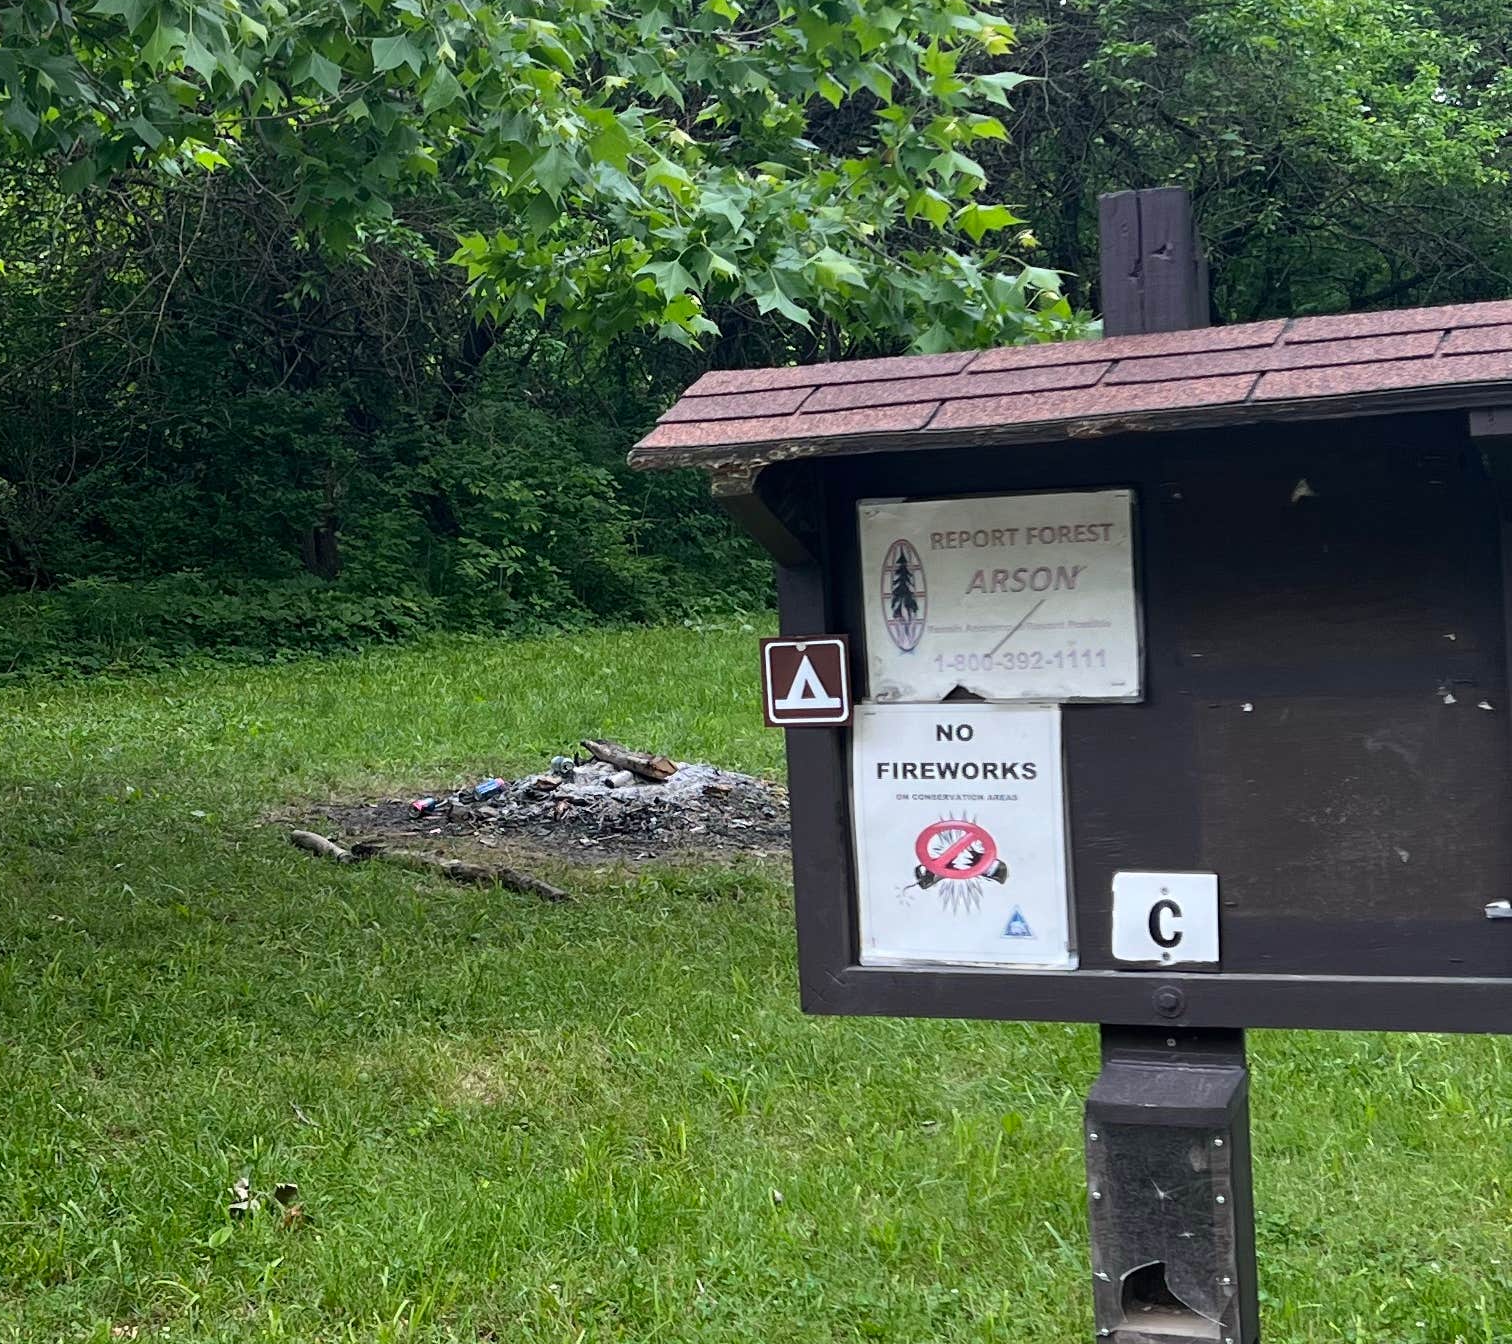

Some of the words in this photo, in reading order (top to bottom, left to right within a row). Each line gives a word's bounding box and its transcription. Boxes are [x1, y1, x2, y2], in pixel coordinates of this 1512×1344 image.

[930, 528, 1020, 550] REPORT
[1026, 523, 1115, 545] FOREST
[965, 565, 1082, 594] ARSON
[933, 648, 1106, 672] 1-800-392-1111
[936, 724, 973, 742] NO
[877, 762, 1037, 780] FIREWORKS
[1148, 899, 1183, 949] C
